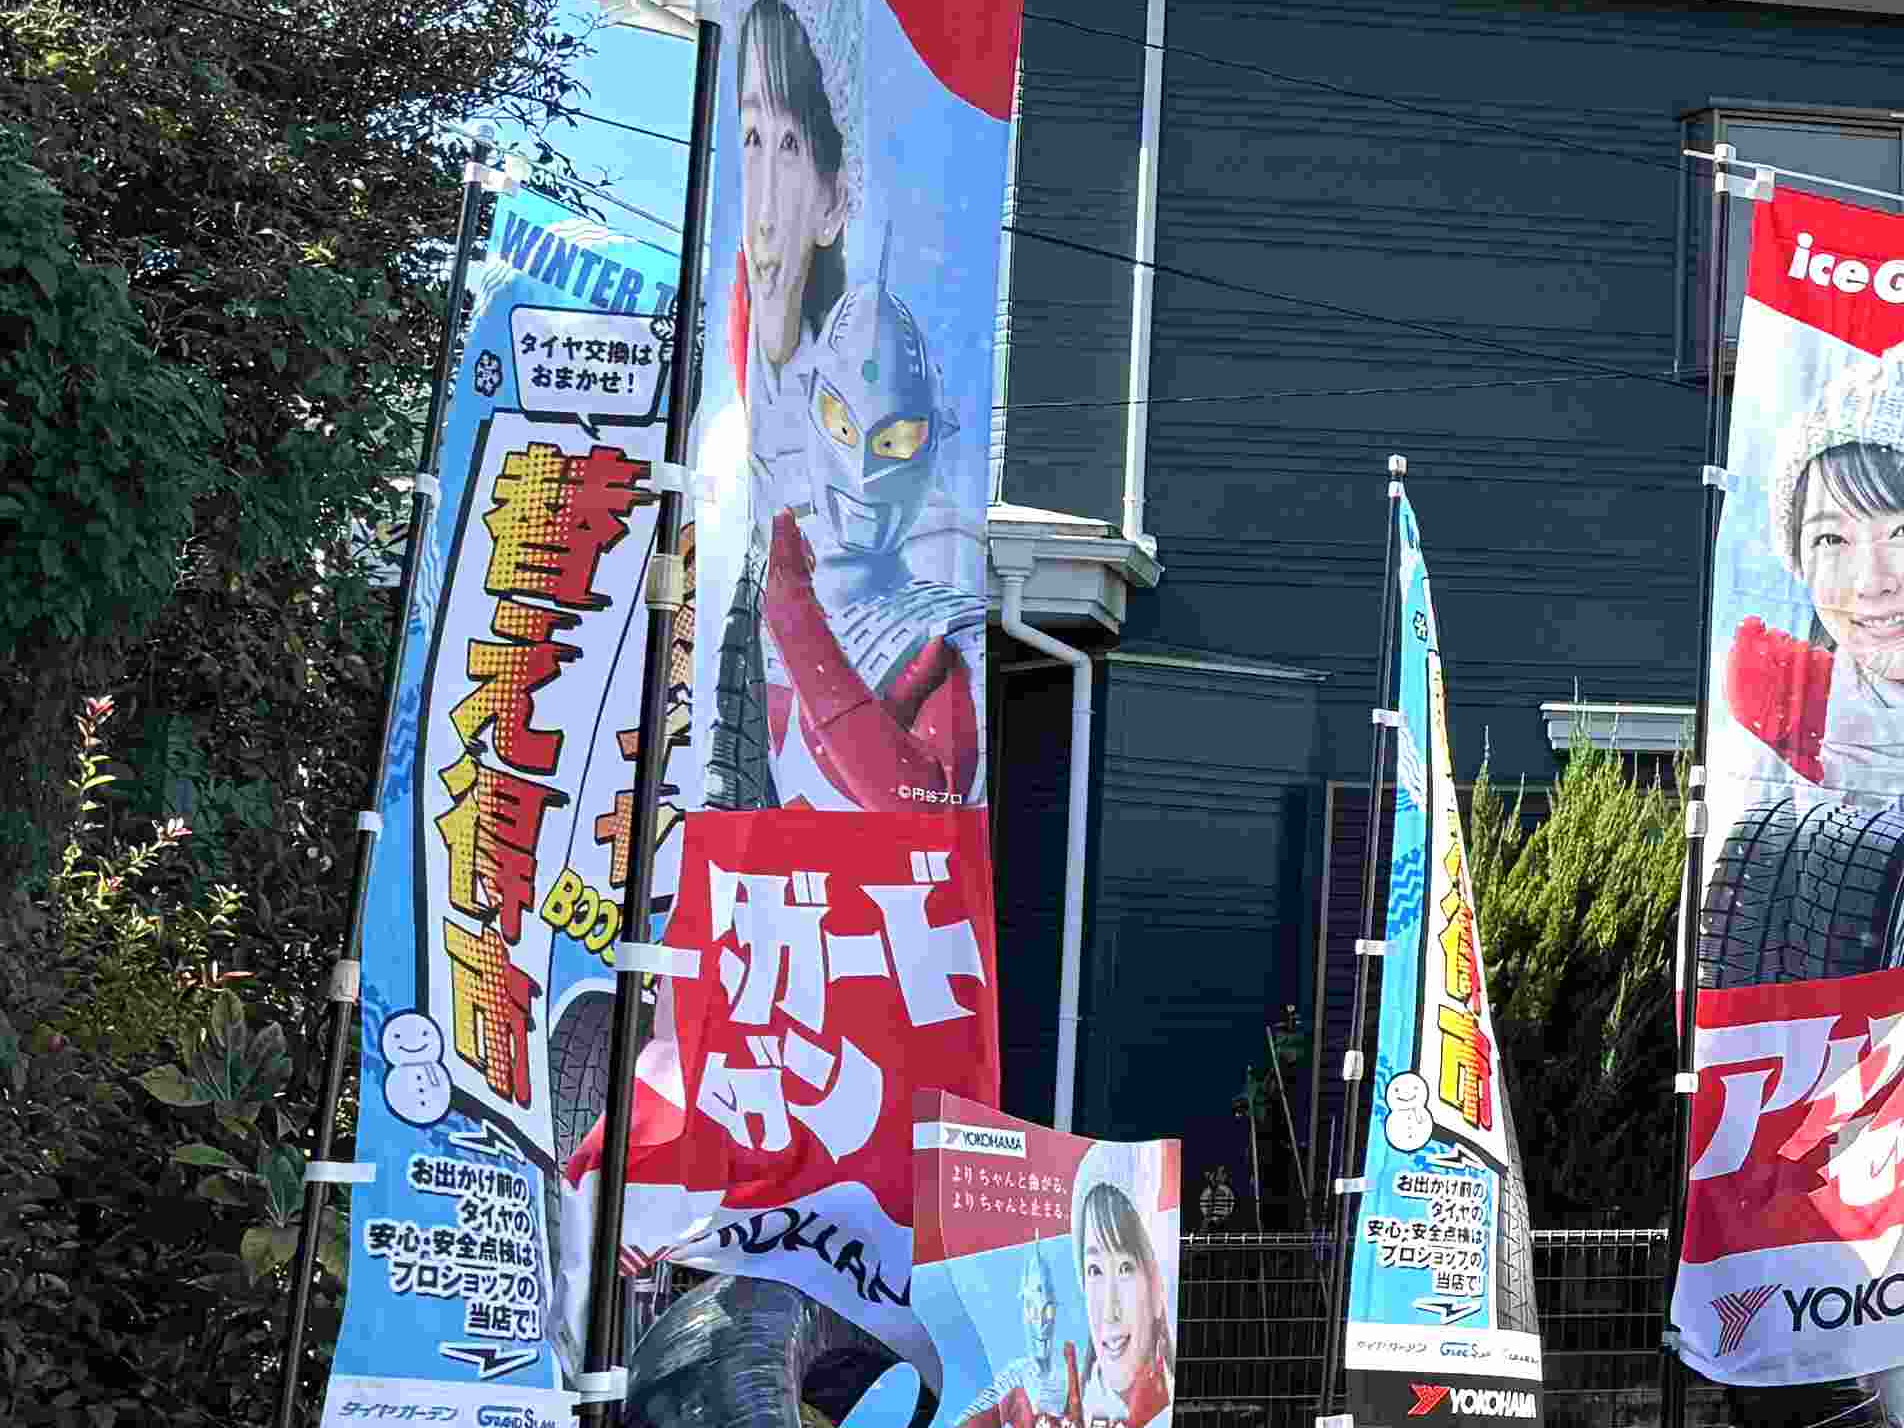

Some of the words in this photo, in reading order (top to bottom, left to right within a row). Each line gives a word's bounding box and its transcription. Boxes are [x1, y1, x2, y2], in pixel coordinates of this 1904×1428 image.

[501, 212, 644, 313] WINTER
[520, 333, 653, 366] タイヤ交換は
[531, 365, 635, 393] おまかせ!
[961, 1130, 1024, 1154] YOKOHAMA
[411, 1158, 529, 1202] お出かけ前の
[1397, 1174, 1485, 1199] お出かけ前の
[461, 1199, 531, 1235] タイヤの
[1432, 1200, 1484, 1222] タイヤの
[369, 1223, 535, 1267] 安心・安全点検は
[1382, 1244, 1482, 1268] プロショップの
[393, 1261, 536, 1300] プロショップの
[470, 1303, 539, 1334] 当店で!
[1450, 1388, 1538, 1419] YOKOHAMA
